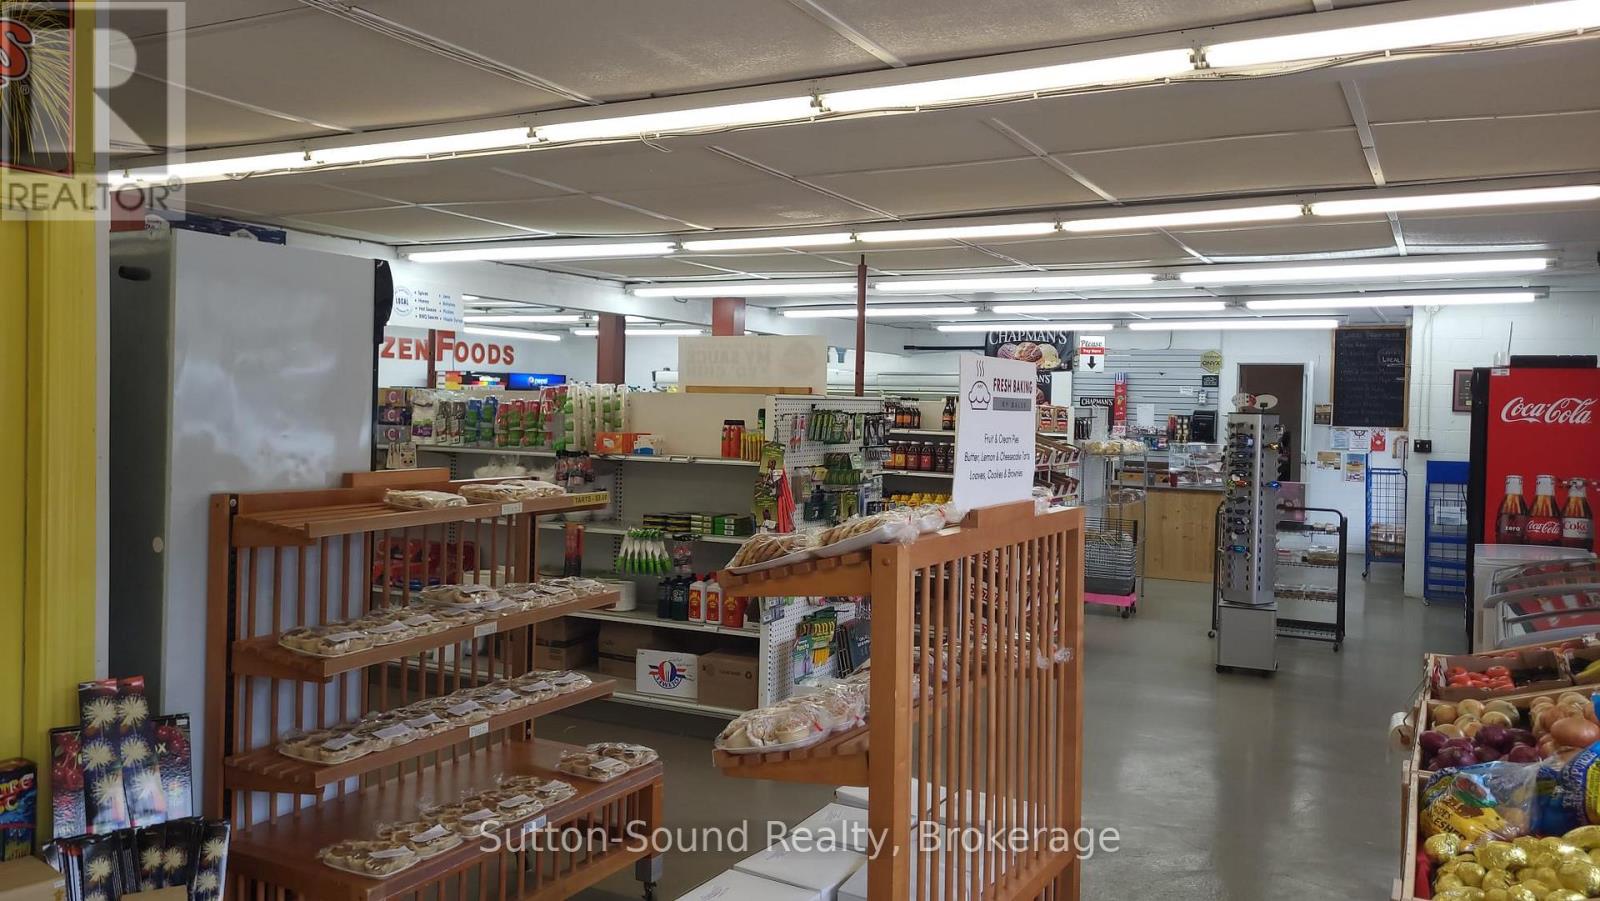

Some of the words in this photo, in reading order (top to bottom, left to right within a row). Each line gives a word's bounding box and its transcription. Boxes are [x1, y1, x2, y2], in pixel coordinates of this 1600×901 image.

[1080, 339, 1103, 347] Please
[993, 378, 1012, 393] FRESH
[1013, 379, 1033, 394] BAKING
[1081, 397, 1114, 406] CHAPMAN'S
[1501, 396, 1598, 424] Coca-Cola
